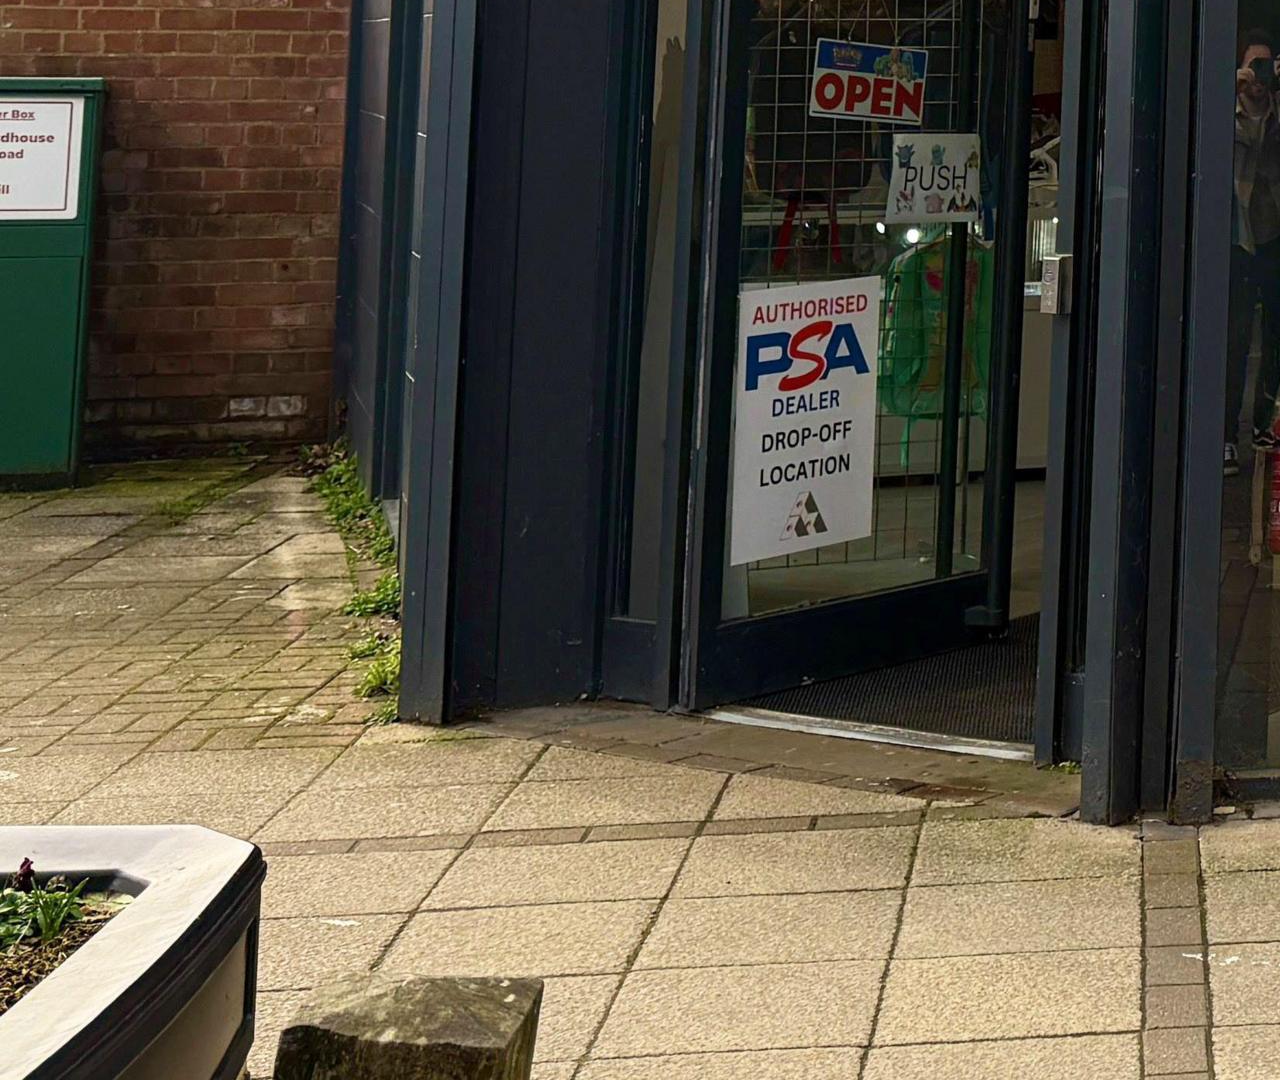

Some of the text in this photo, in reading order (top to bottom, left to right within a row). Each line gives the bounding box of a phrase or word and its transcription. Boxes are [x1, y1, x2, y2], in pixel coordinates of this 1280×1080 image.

[815, 72, 924, 119] OPEN
[11, 110, 36, 119] Box
[1, 133, 55, 143] dhouse
[903, 165, 968, 192] PUSH
[753, 293, 869, 326] AUTHORISED
[745, 320, 870, 392] PSA
[771, 389, 841, 418] DEALER
[761, 420, 852, 454] DROP-OFF
[759, 452, 852, 487] LOCATION
